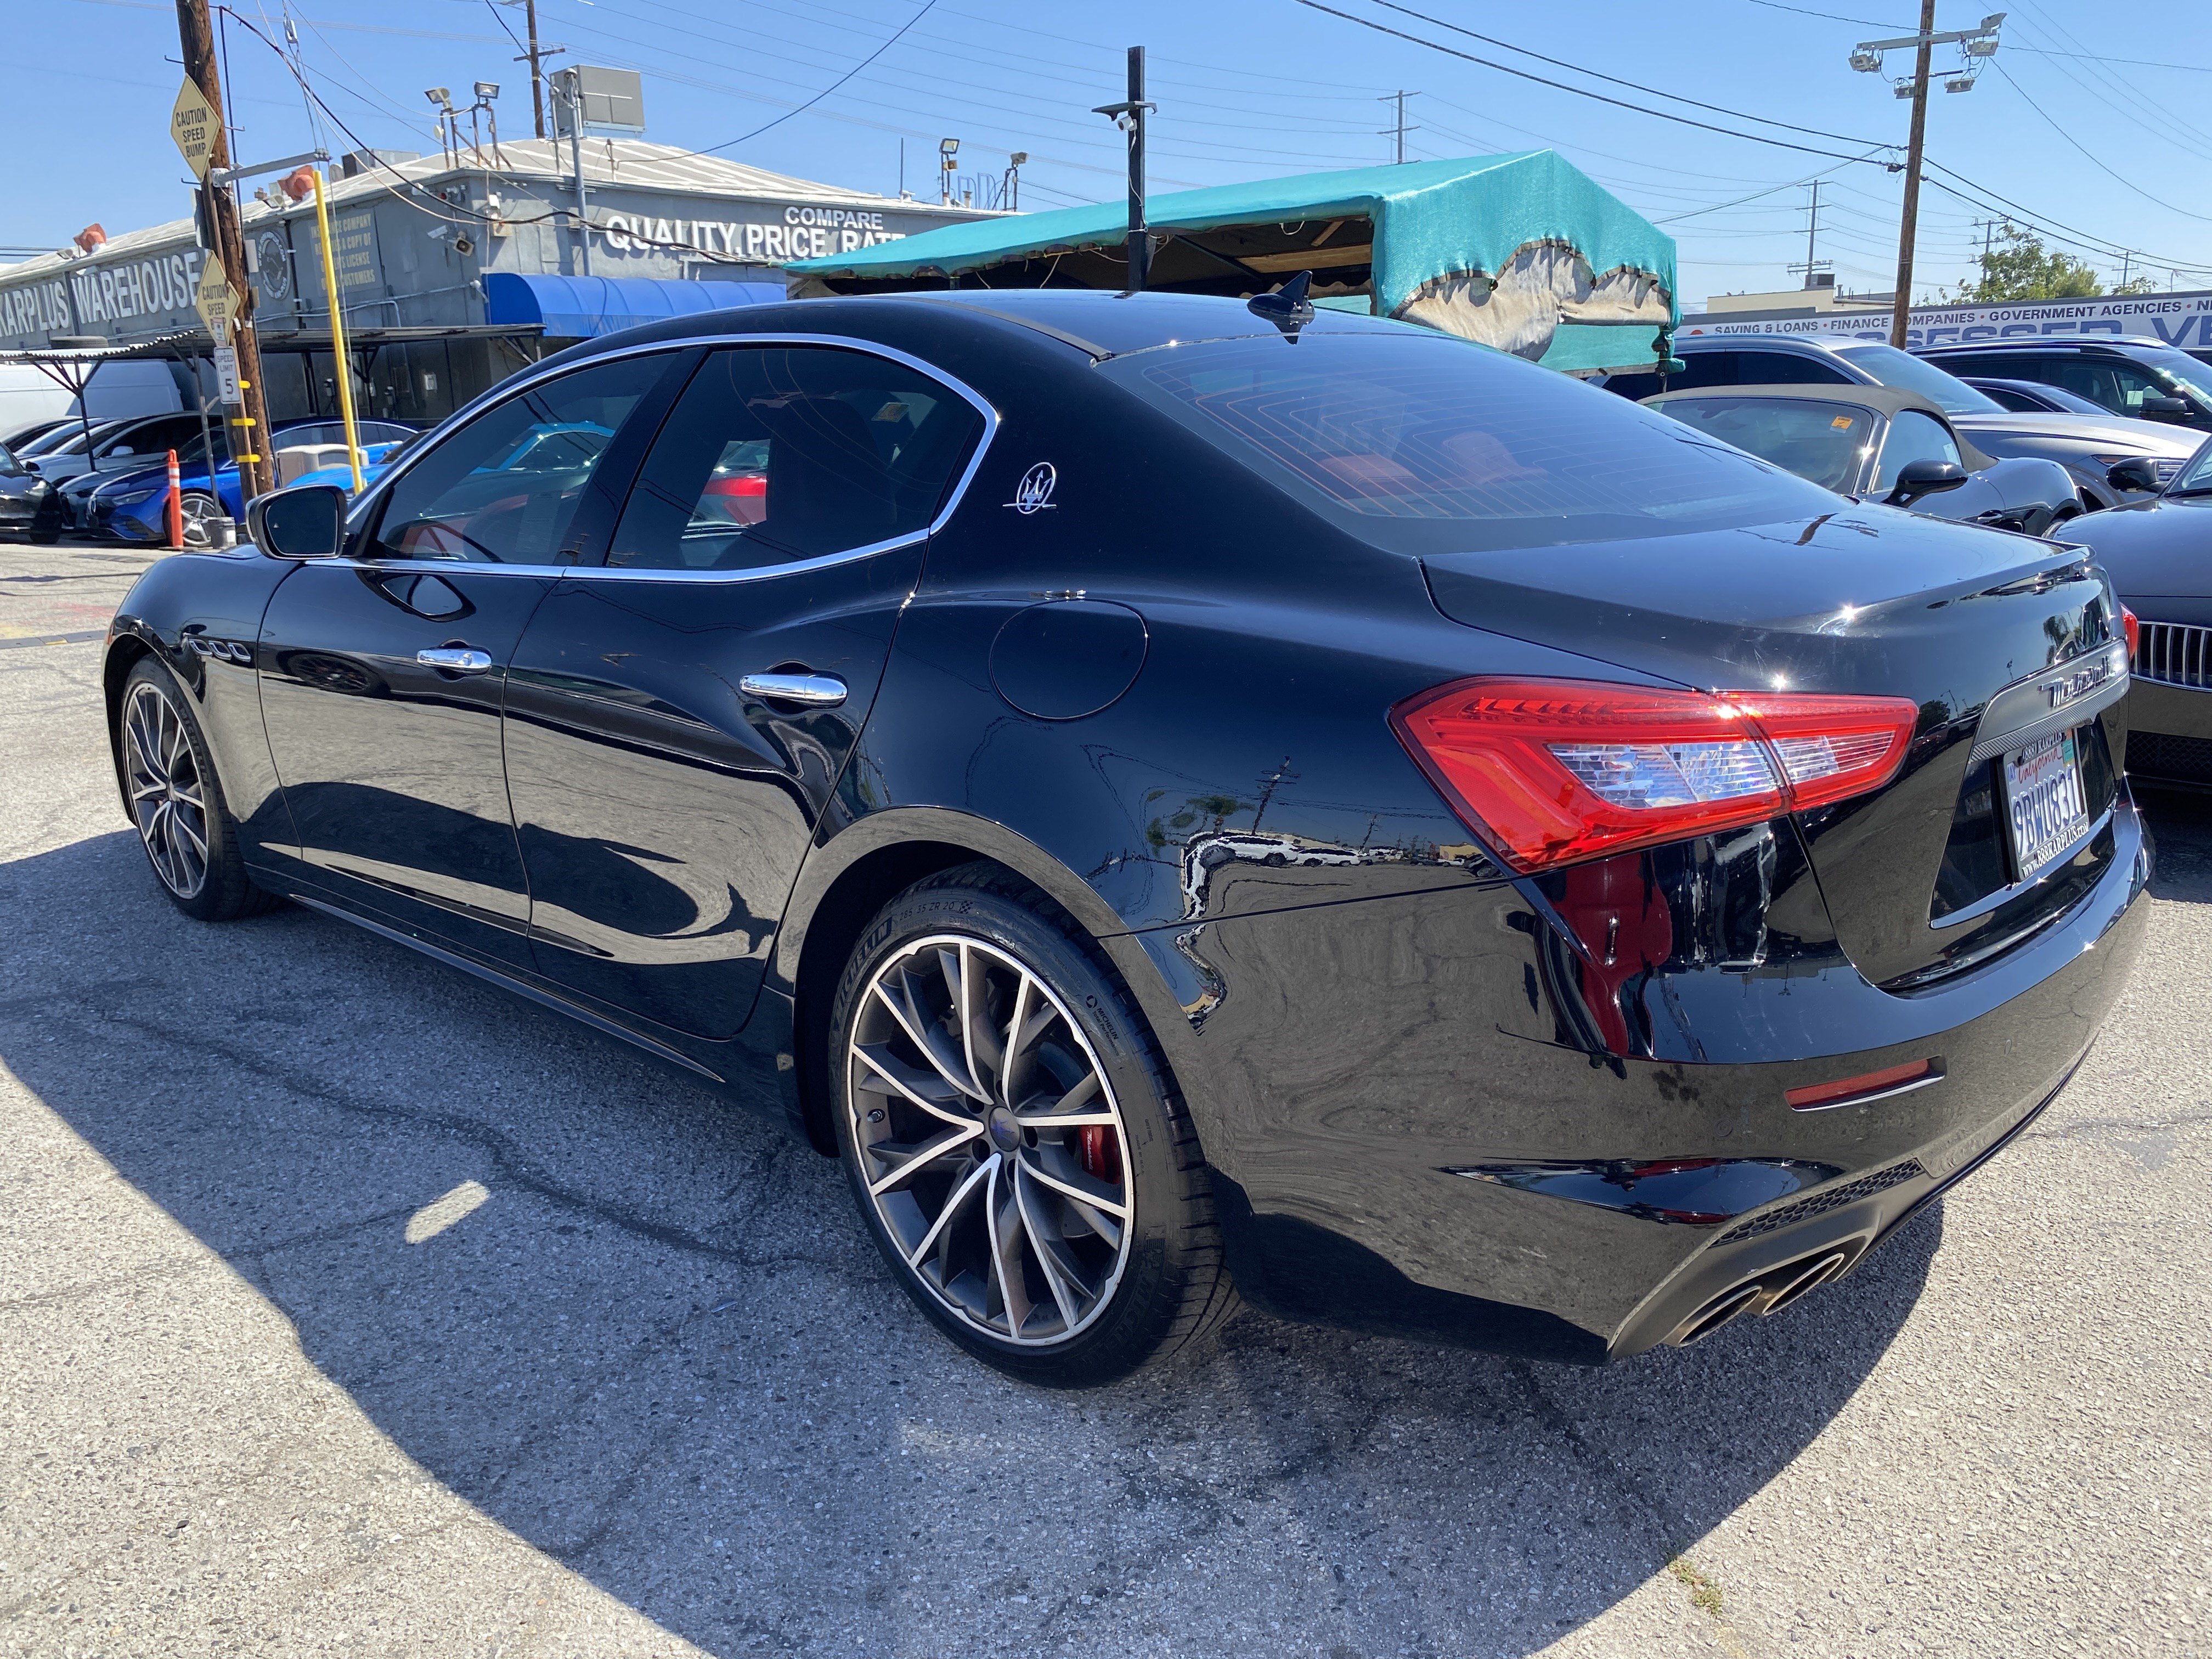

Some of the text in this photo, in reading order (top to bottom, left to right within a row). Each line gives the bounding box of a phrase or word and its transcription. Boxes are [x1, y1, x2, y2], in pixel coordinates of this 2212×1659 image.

[176, 107, 207, 127] CAUTION
[183, 127, 205, 143] SPEED
[186, 143, 206, 157] BUMP
[343, 213, 371, 232] COMPANY
[785, 206, 883, 230] COMPARE
[347, 234, 362, 250] COPY
[364, 233, 371, 246] OF
[347, 251, 370, 268] LICENSE
[71, 251, 200, 324] WAREHOUSE
[202, 284, 228, 300] CAUTION
[208, 302, 225, 315] SPEED
[1715, 324, 1760, 334] SAVING
[1765, 324, 1773, 333] &
[1776, 321, 1818, 333] LOANS
[1831, 317, 1889, 330] FINANCE
[1990, 306, 2096, 321] GOVERNMENT
[2101, 301, 2182, 315] AGENCIES
[225, 378, 234, 394] 5
[2038, 732, 2062, 754] KARPLUS
[2019, 747, 2062, 784] California
[2012, 764, 2081, 858] 9BWU831
[835, 918, 892, 1022] MICHELIN
[1092, 1011, 1102, 1023] Total
[1097, 1008, 1119, 1040] MICHELIN
